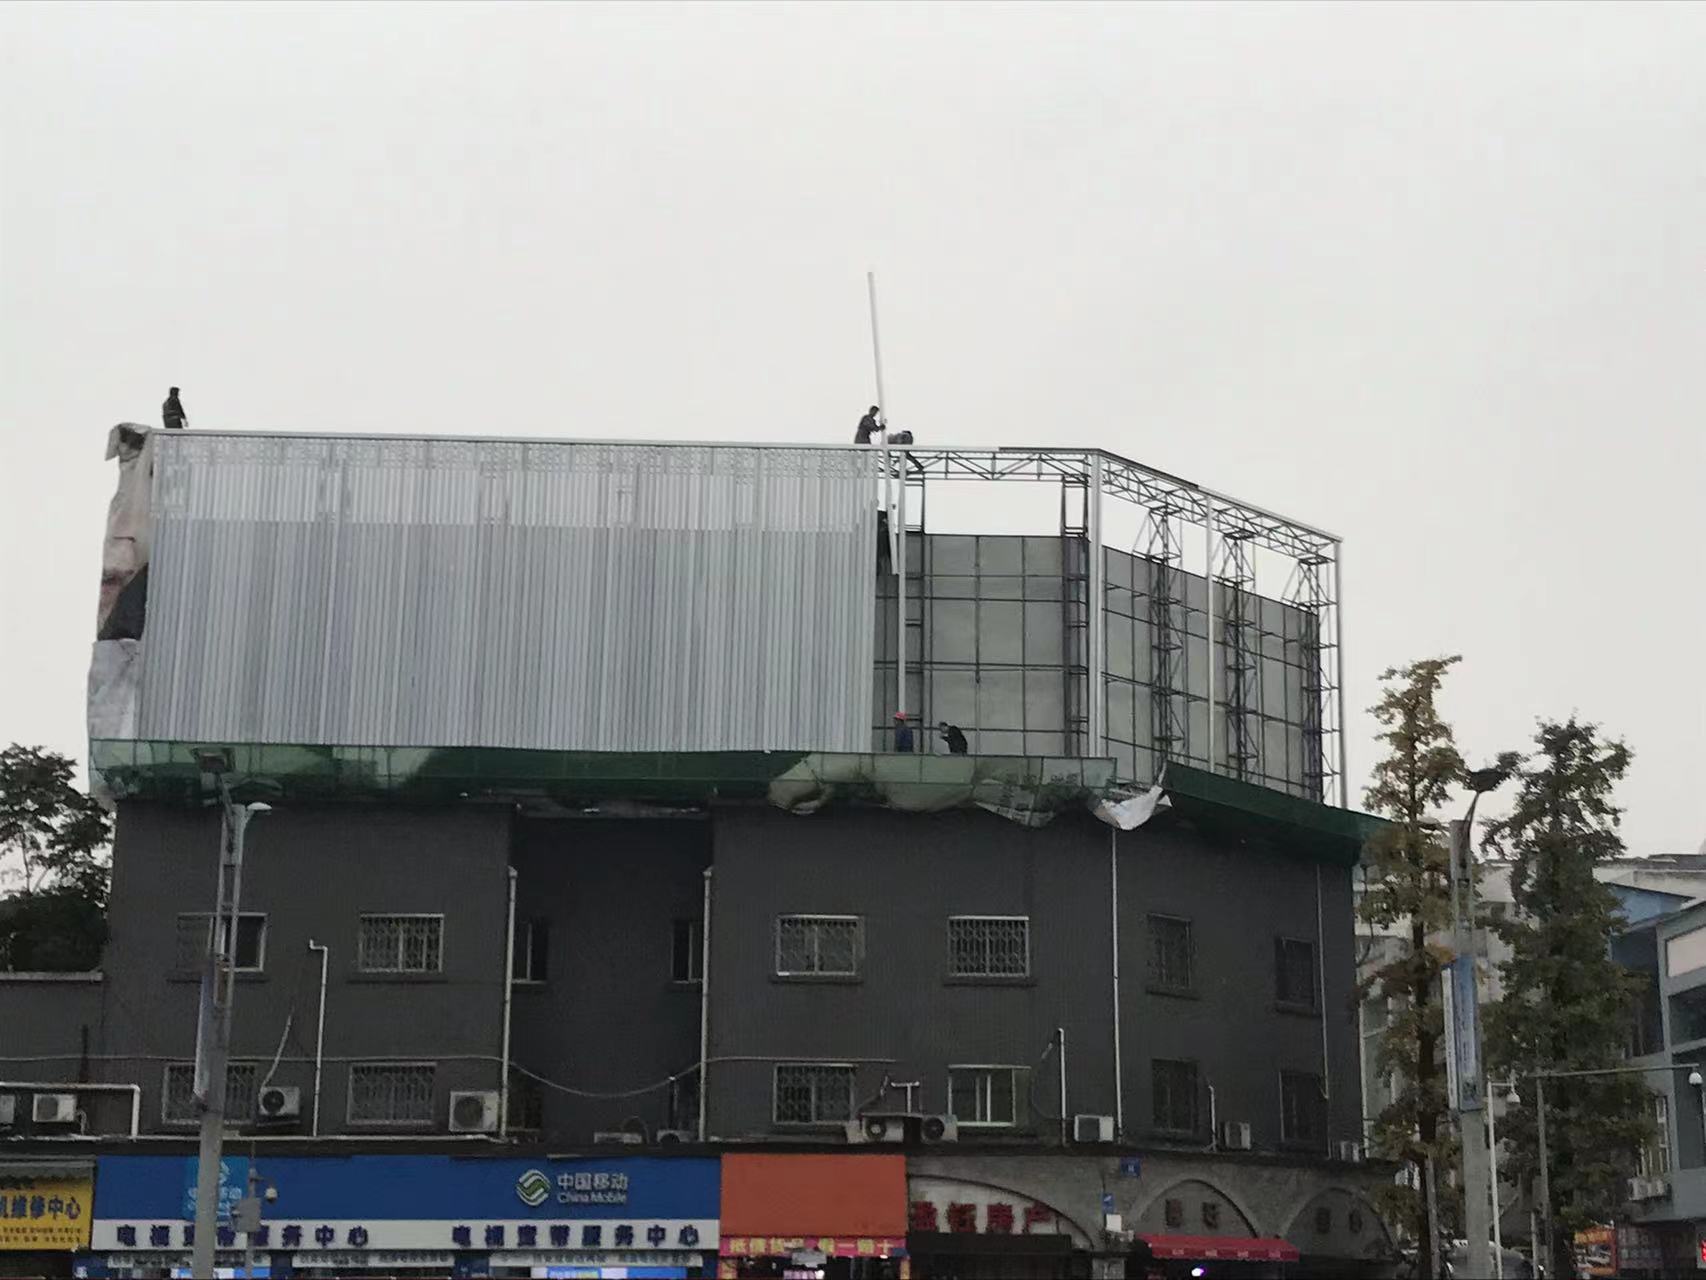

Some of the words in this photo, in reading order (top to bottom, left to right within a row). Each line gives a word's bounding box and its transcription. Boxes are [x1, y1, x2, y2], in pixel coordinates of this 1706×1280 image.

[557, 1172, 628, 1190] 中国移动
[557, 1191, 589, 1204] China
[590, 1191, 627, 1204] Mobile
